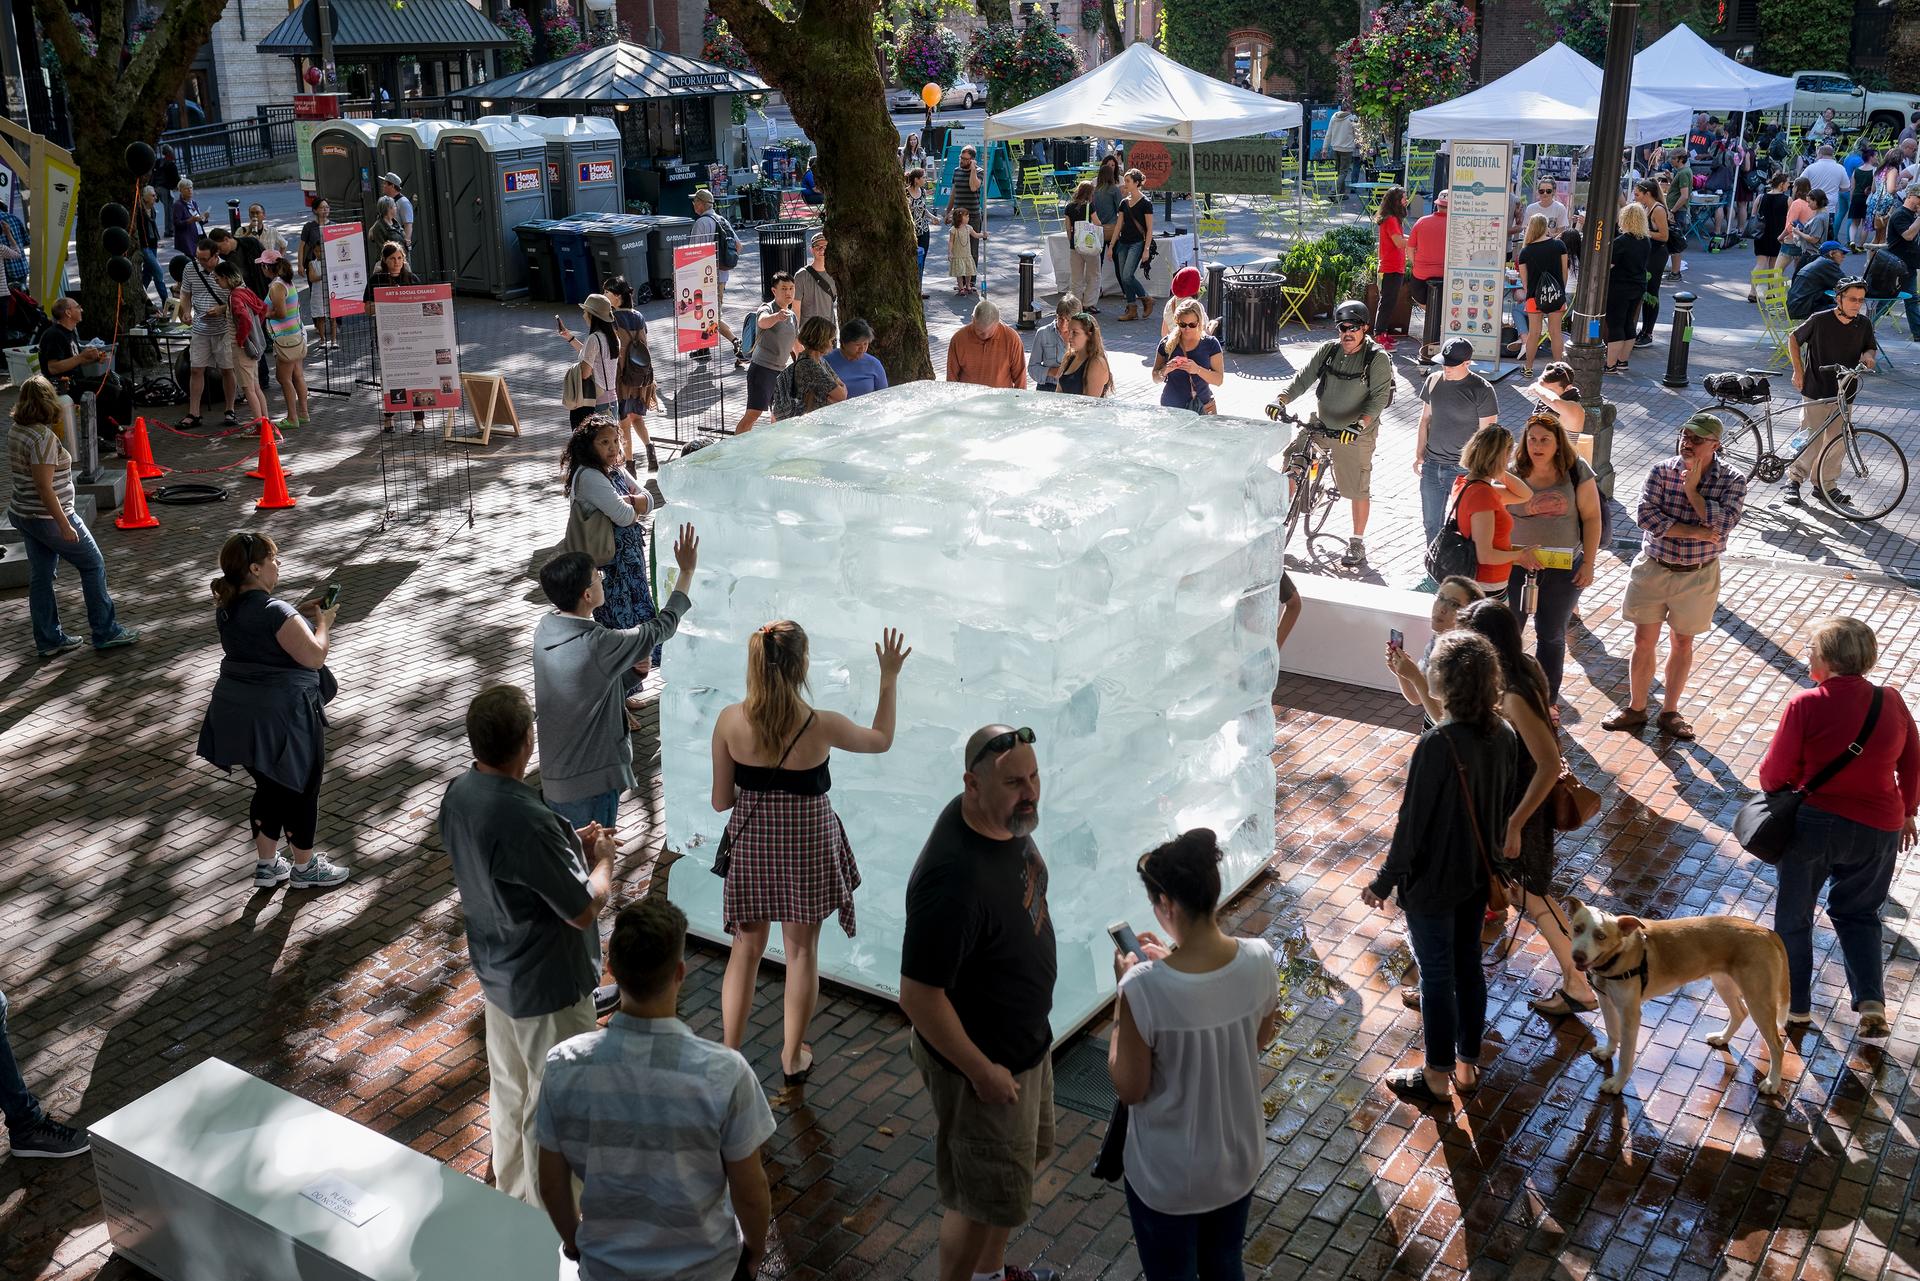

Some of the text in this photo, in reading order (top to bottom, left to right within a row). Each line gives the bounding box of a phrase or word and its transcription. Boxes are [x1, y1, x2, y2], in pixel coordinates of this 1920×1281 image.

[670, 73, 729, 87] INFORMATION
[1131, 152, 1155, 161] URBAN
[1131, 161, 1169, 173] MARKET
[1456, 156, 1501, 169] OCCIDENTAL
[589, 163, 610, 173] Honey
[515, 172, 537, 182] Honey
[590, 171, 613, 180] Bucket
[669, 173, 696, 181] INFORMATION
[1455, 170, 1475, 182] PARK
[516, 180, 539, 190] Bucket
[665, 234, 687, 242] GARBAGE
[1594, 220, 1604, 251] 205
[621, 240, 644, 250] GARBAGE
[330, 1191, 355, 1207] PLEASE
[311, 1191, 357, 1218] DO NOT STAND
